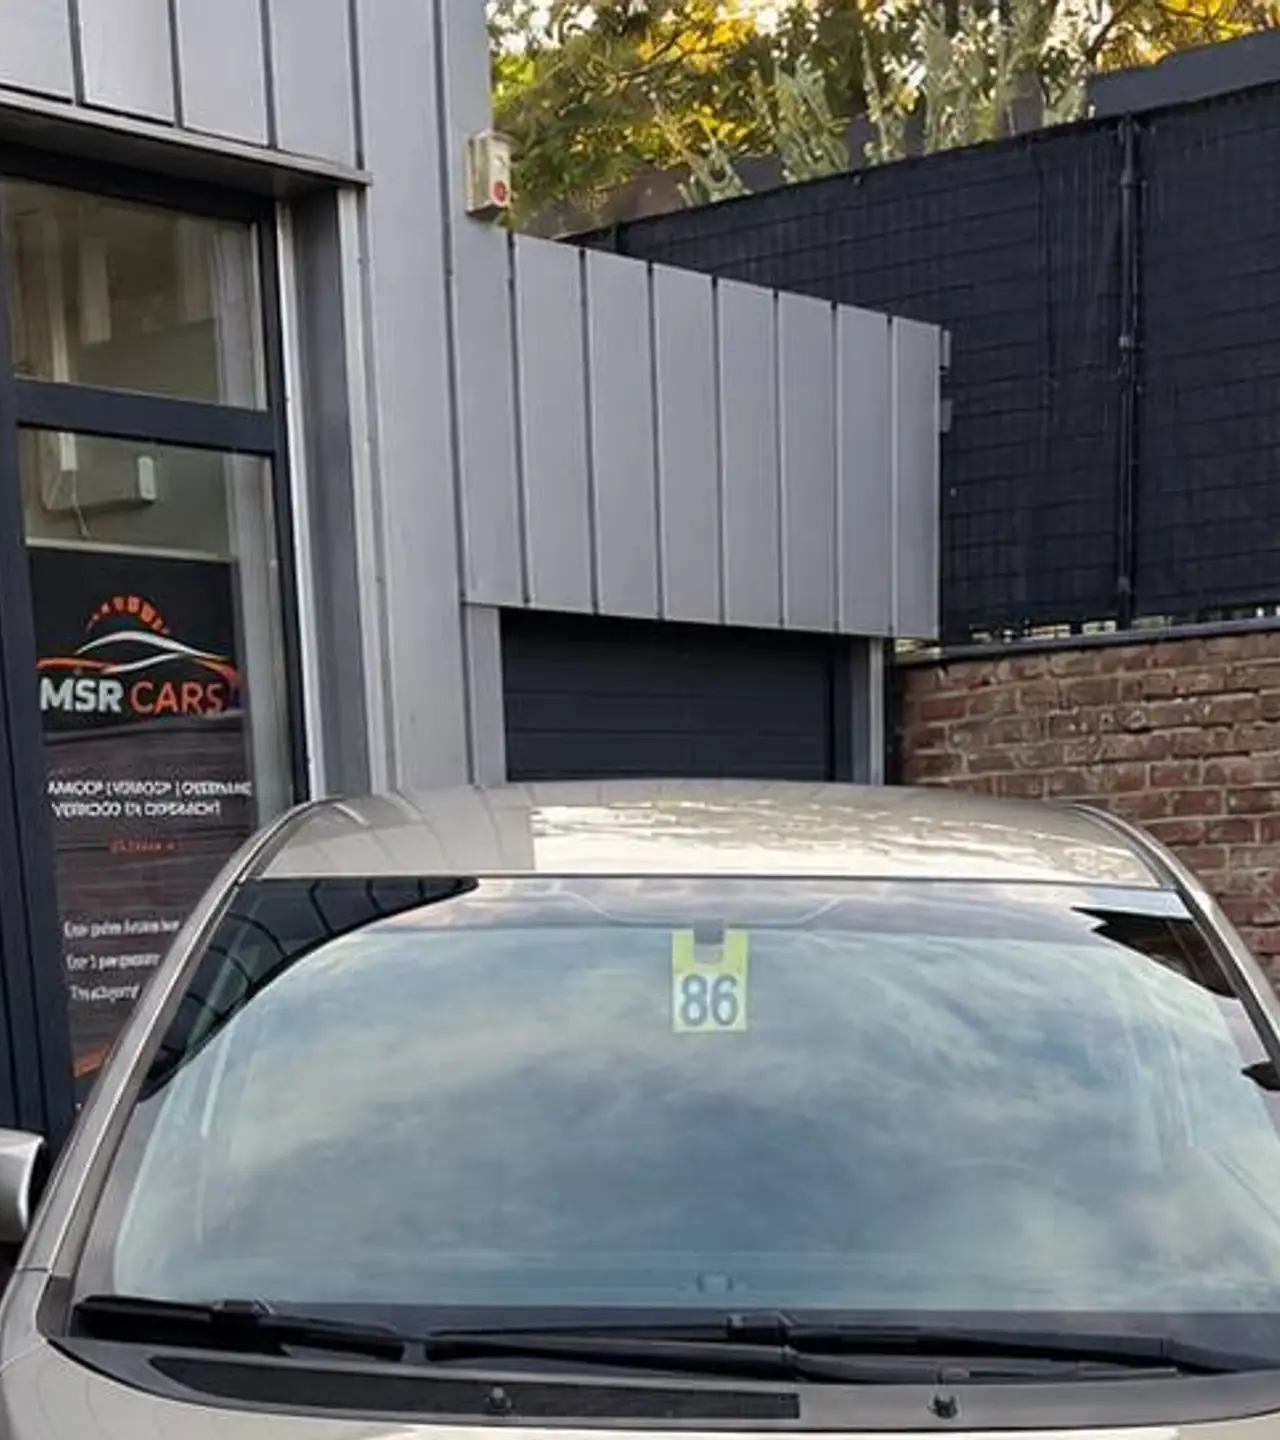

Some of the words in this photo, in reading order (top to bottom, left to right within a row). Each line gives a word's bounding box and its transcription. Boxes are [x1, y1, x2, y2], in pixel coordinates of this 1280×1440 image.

[40, 677, 124, 713] MSR
[130, 680, 224, 716] CARS
[681, 974, 739, 1027] 86
